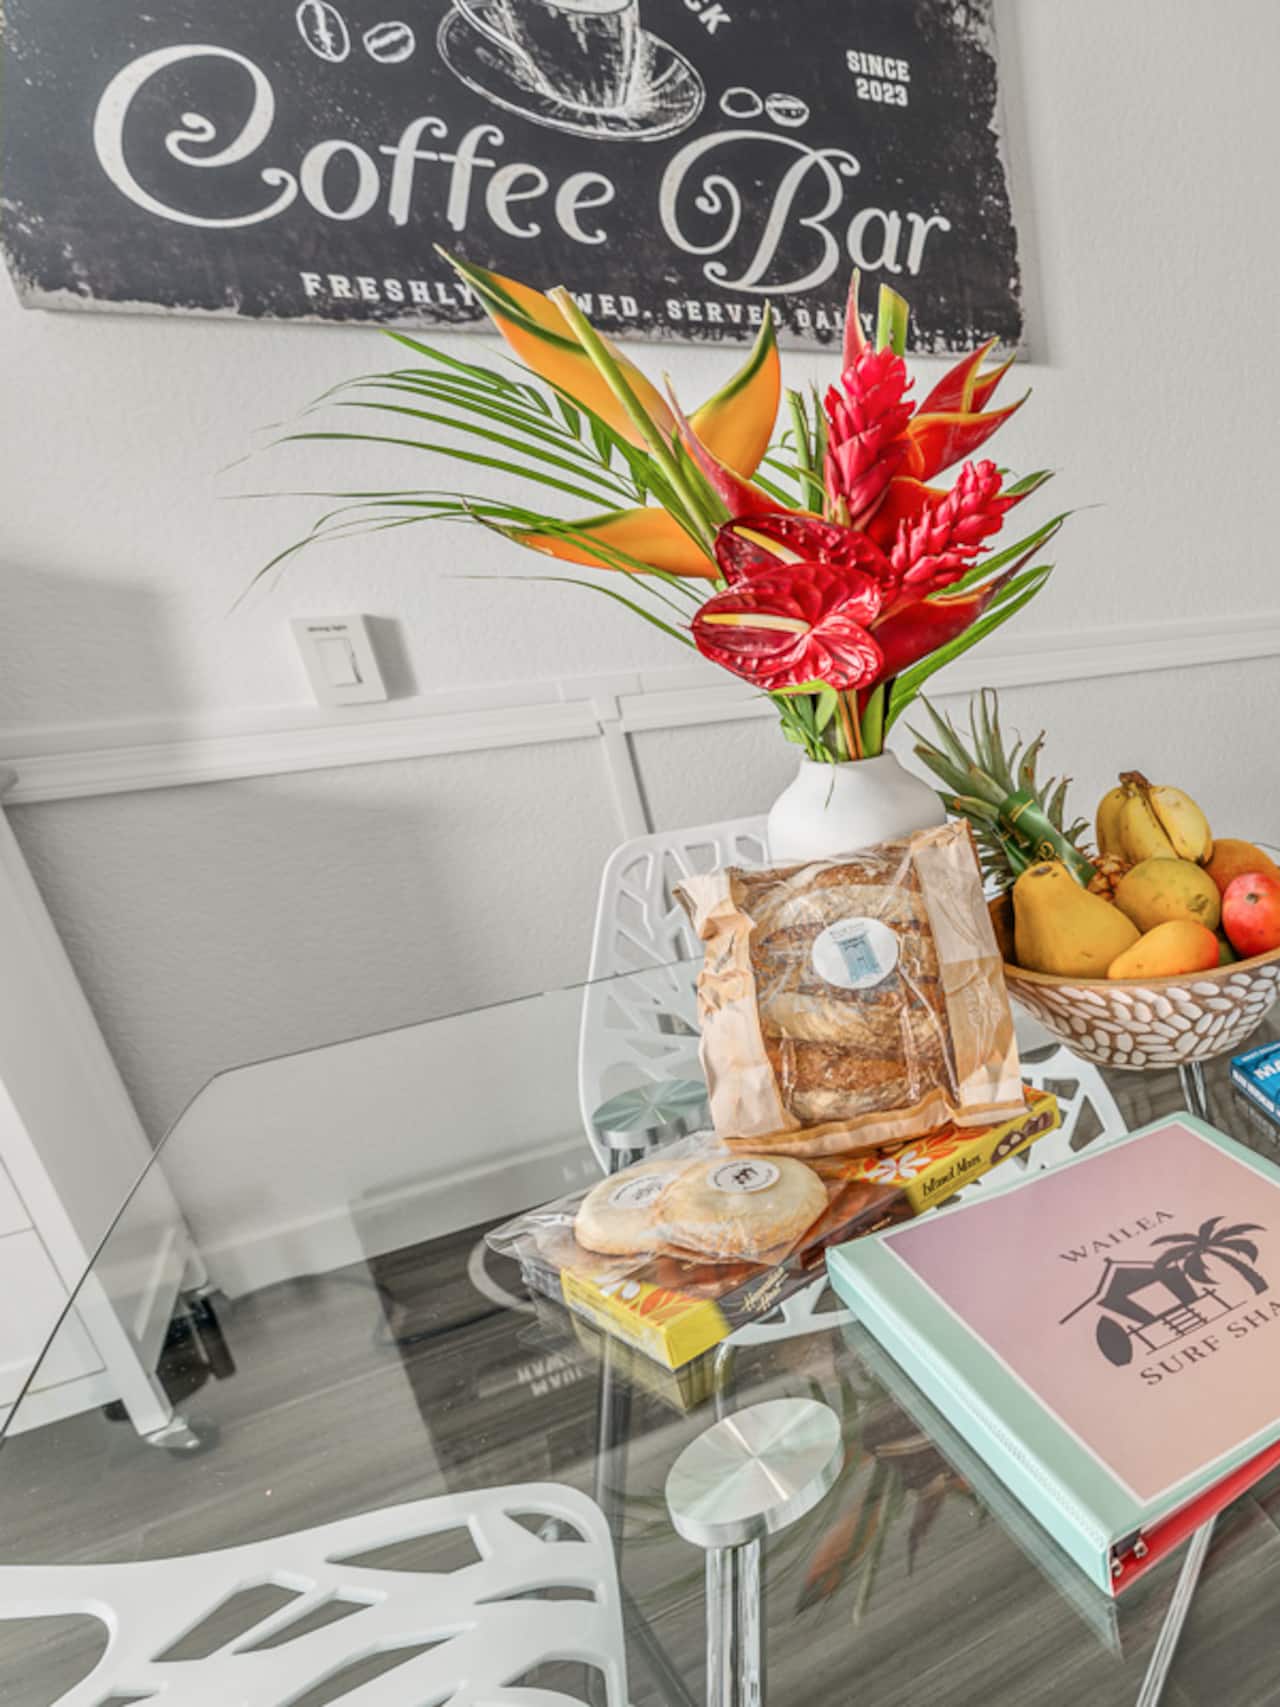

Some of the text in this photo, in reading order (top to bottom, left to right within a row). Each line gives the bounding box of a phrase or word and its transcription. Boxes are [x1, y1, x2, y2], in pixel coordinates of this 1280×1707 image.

[846, 50, 911, 82] SINCE
[855, 77, 909, 108] 2023
[93, 43, 951, 294] Coffee Bar
[300, 271, 476, 306] FRESHLY
[797, 307, 874, 332] DAIY
[1059, 1210, 1174, 1262] WAILEA
[1140, 1335, 1221, 1386] SURF
